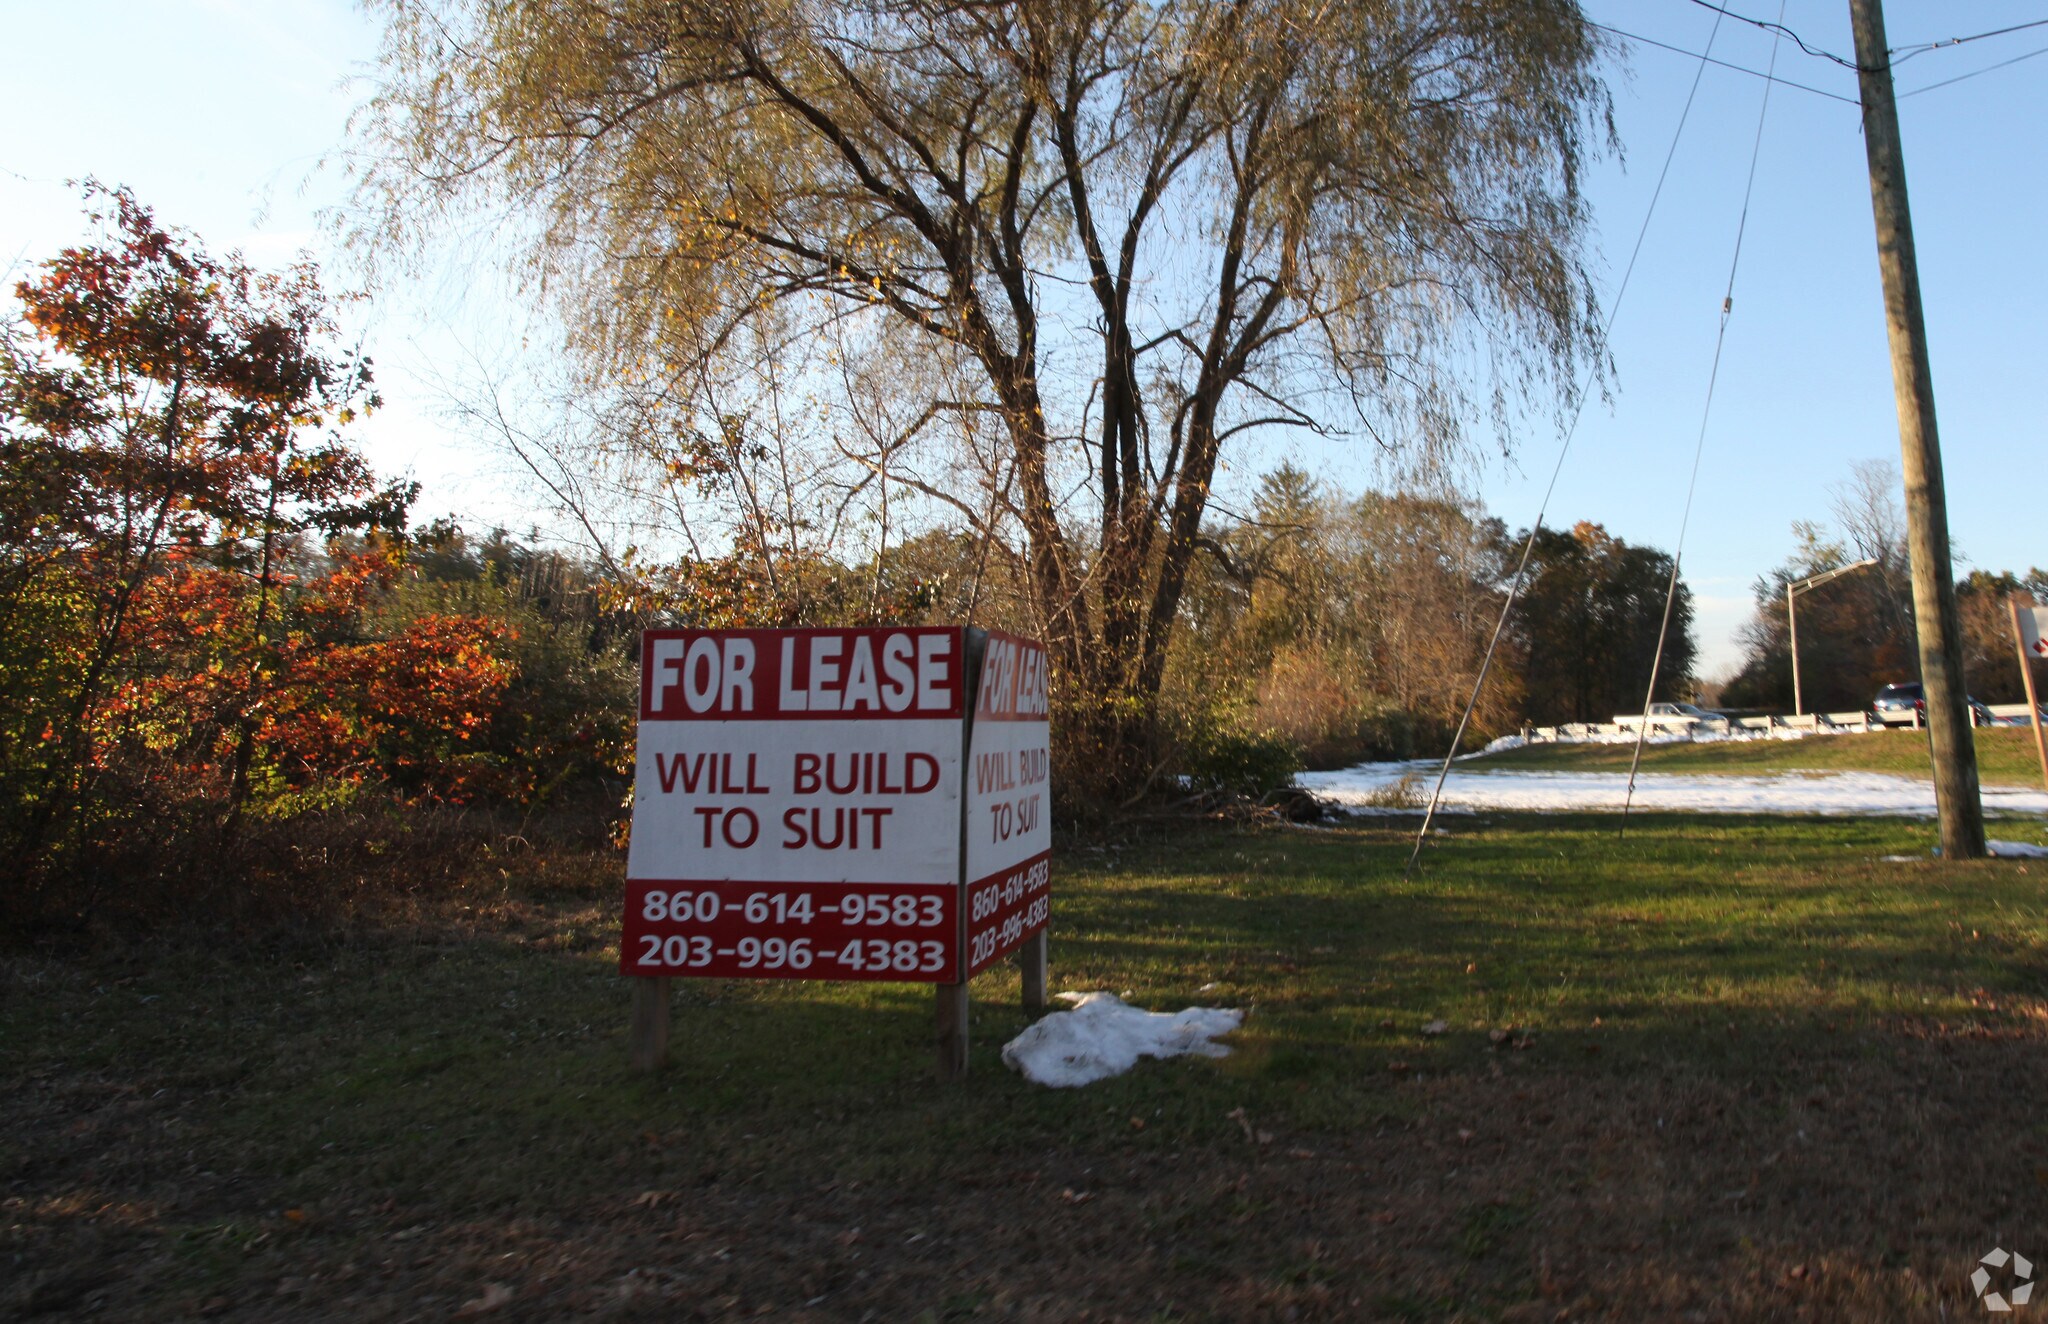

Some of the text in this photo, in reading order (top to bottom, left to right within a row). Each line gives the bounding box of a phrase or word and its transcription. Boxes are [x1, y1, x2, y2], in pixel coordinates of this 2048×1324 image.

[650, 634, 952, 713] FOR LEASE
[979, 638, 1049, 715] FOR LEAS
[655, 752, 940, 795] WILL BUILD
[976, 747, 1046, 795] WILL BUILD
[694, 806, 893, 850] TO SUIT
[991, 793, 1040, 844] TO SUIT
[642, 890, 943, 927] 860-614-9583
[972, 859, 1049, 922] 860-614-9583
[637, 934, 945, 973] 203-996-4383
[971, 894, 1049, 968] 203-996-4383
